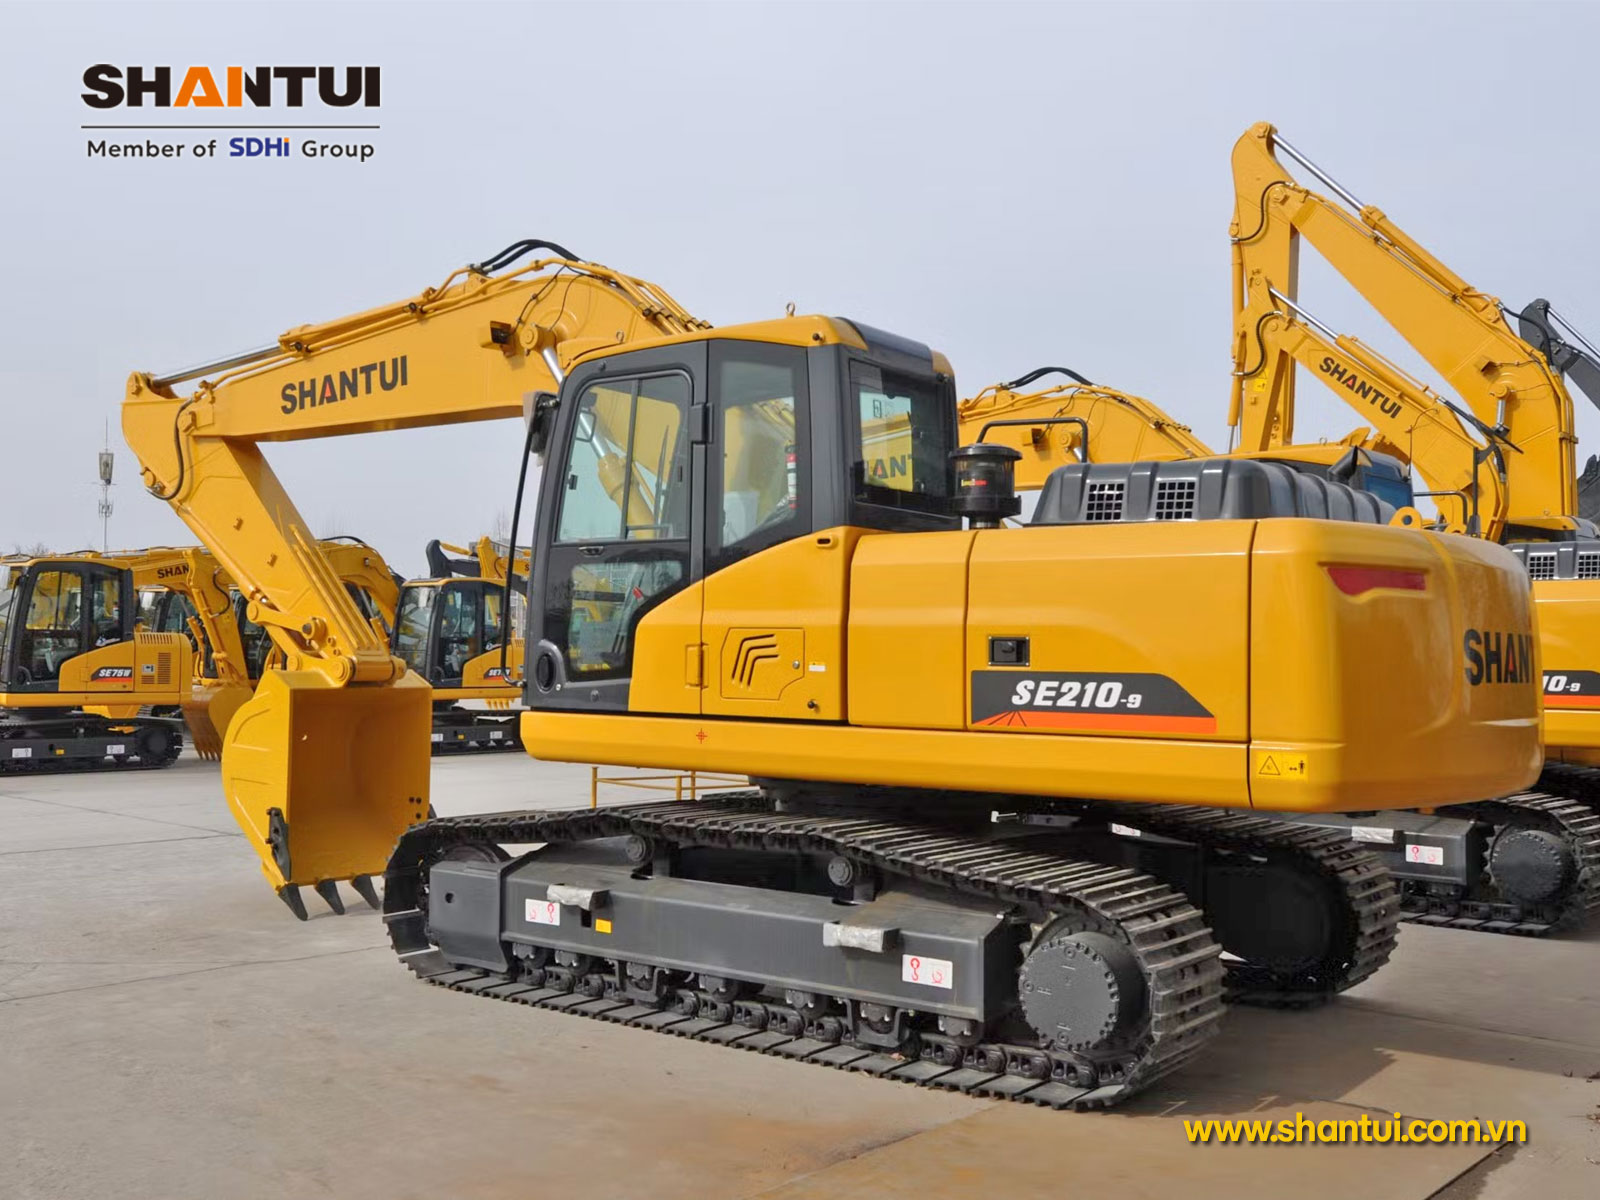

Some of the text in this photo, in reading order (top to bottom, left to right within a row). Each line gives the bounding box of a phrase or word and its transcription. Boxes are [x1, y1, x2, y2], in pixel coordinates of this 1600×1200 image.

[281, 355, 408, 415] SHANTUI
[1319, 357, 1403, 419] SHANTUI
[1011, 680, 1142, 708] SE210-9
